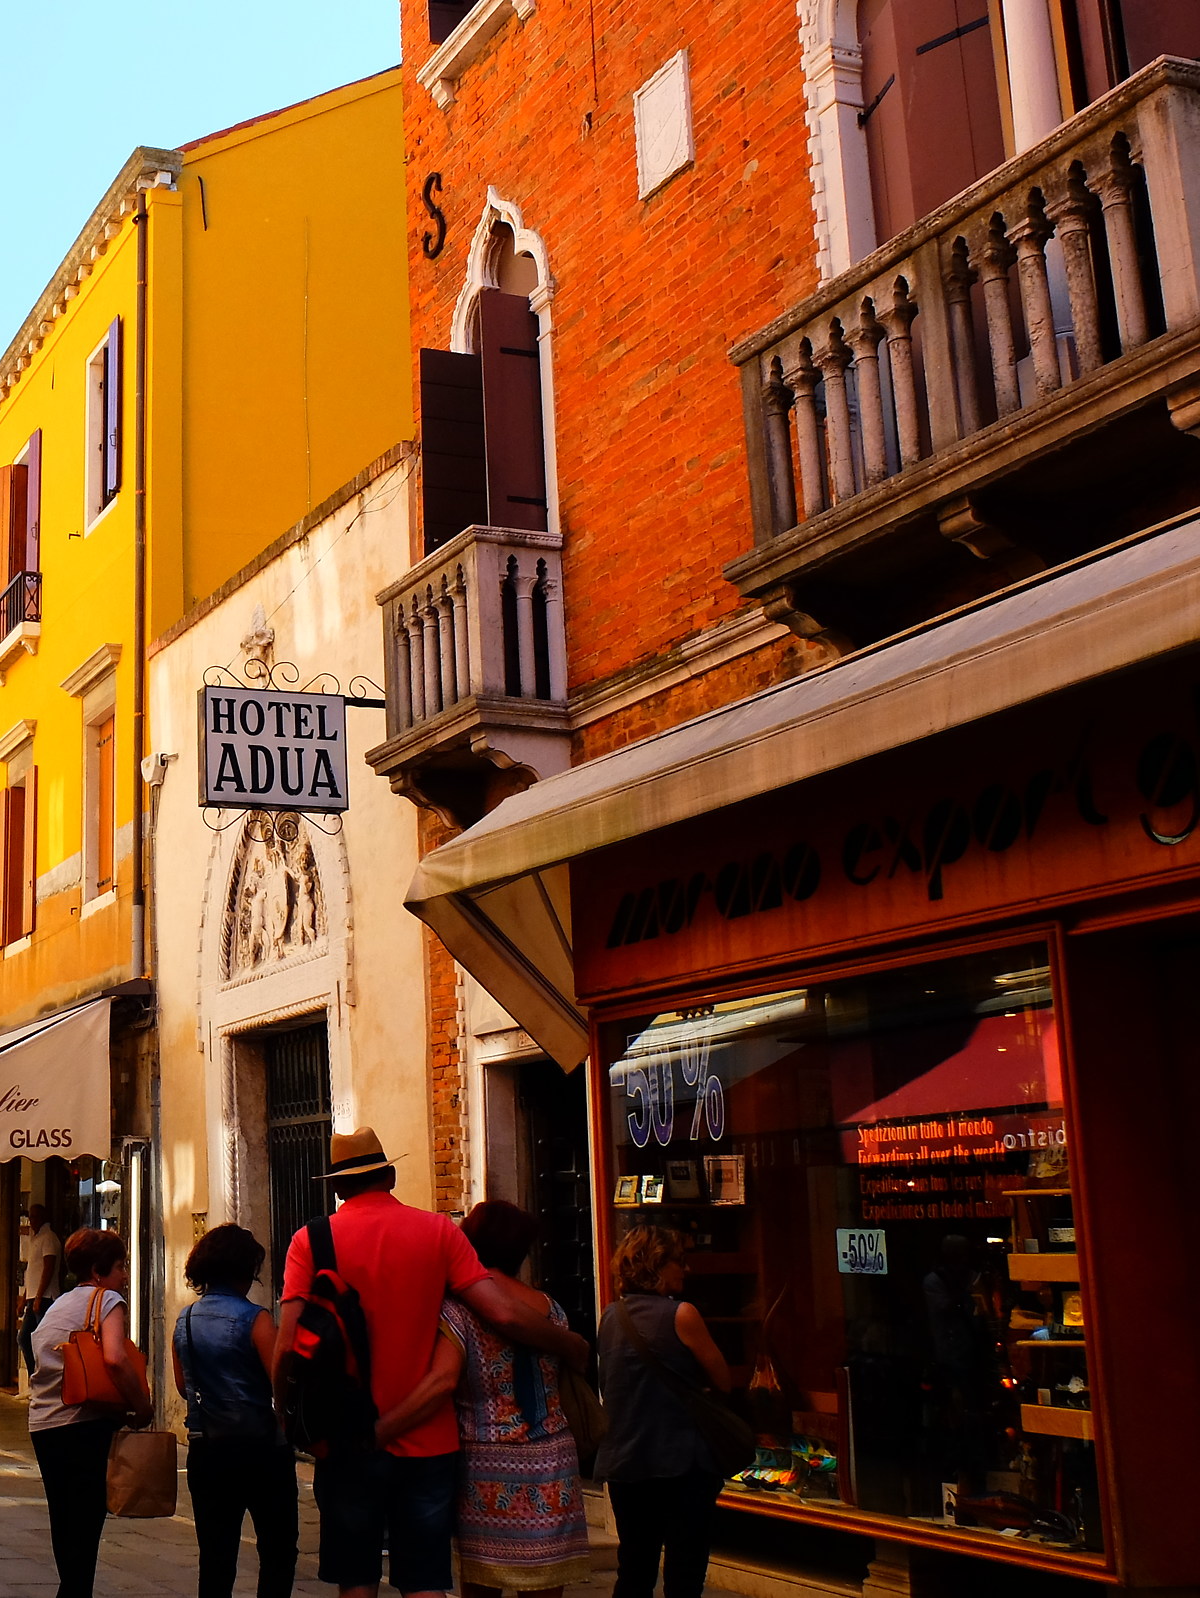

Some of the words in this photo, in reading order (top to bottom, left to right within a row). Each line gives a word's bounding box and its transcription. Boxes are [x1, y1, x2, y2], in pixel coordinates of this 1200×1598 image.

[211, 697, 338, 741] HOTEL
[213, 742, 342, 799] ADUA
[9, 1128, 73, 1148] GLASS
[920, 1121, 943, 1139] tutto
[959, 1117, 995, 1136] mondo
[842, 1233, 884, 1271] -50%
